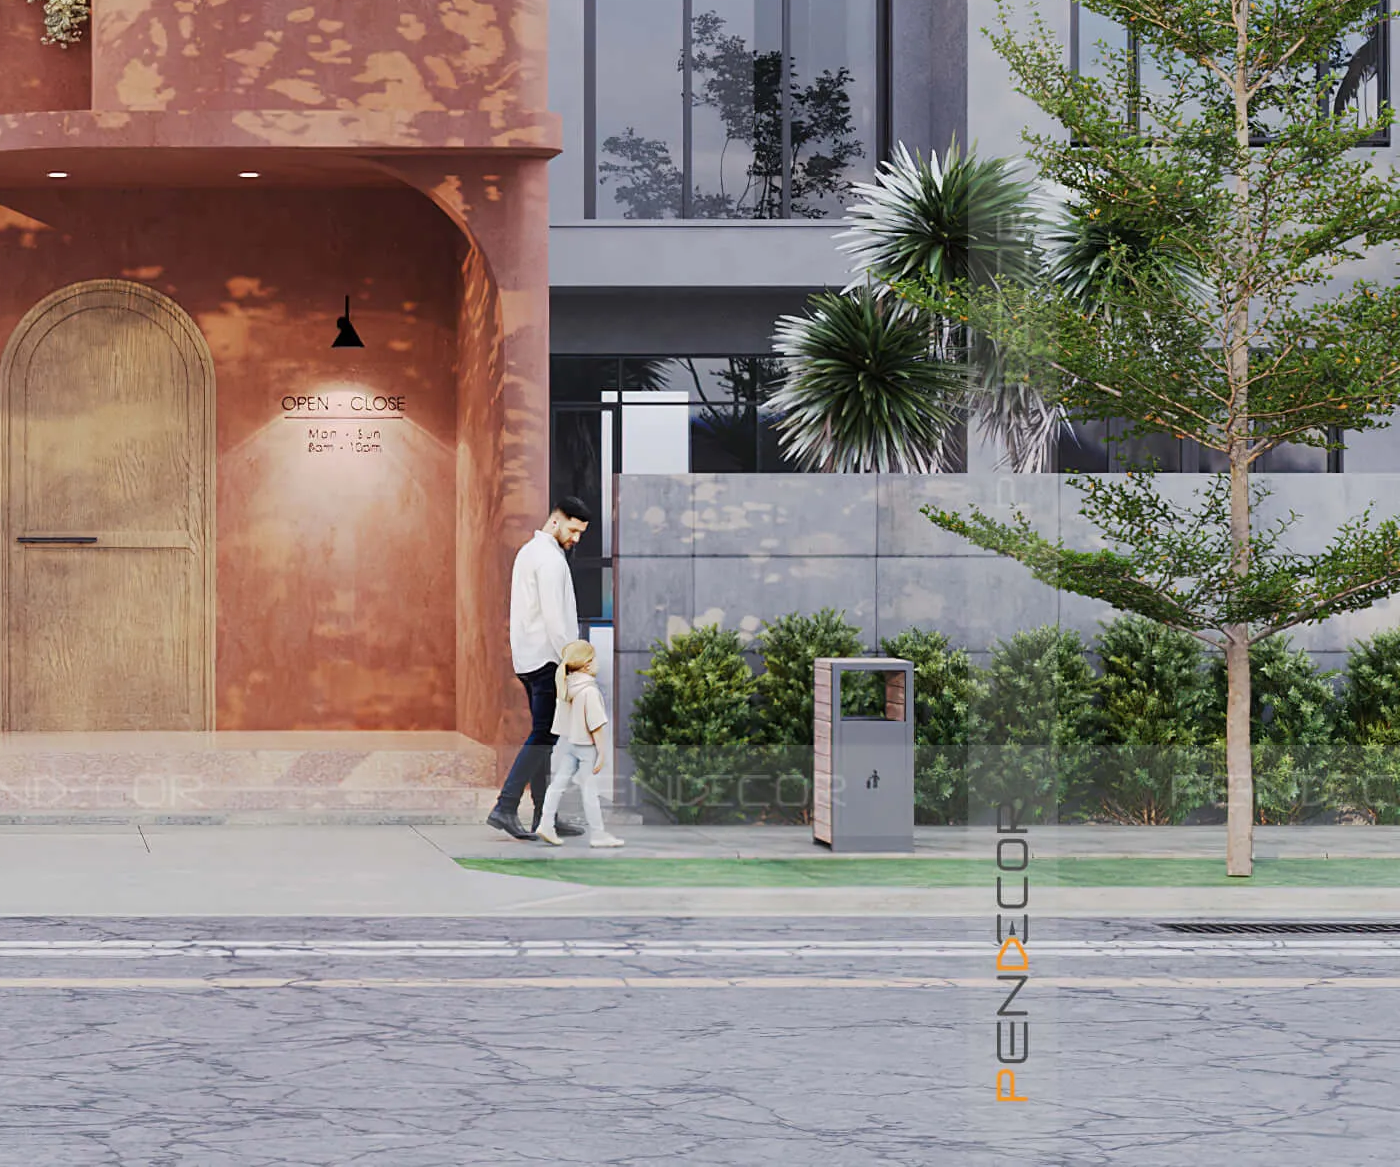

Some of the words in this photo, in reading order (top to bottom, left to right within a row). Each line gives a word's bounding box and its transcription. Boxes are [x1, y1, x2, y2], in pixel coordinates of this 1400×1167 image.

[282, 396, 329, 411] OPEN
[351, 396, 406, 411] CLOSE
[308, 429, 337, 439] Mon
[358, 429, 381, 439] Sun
